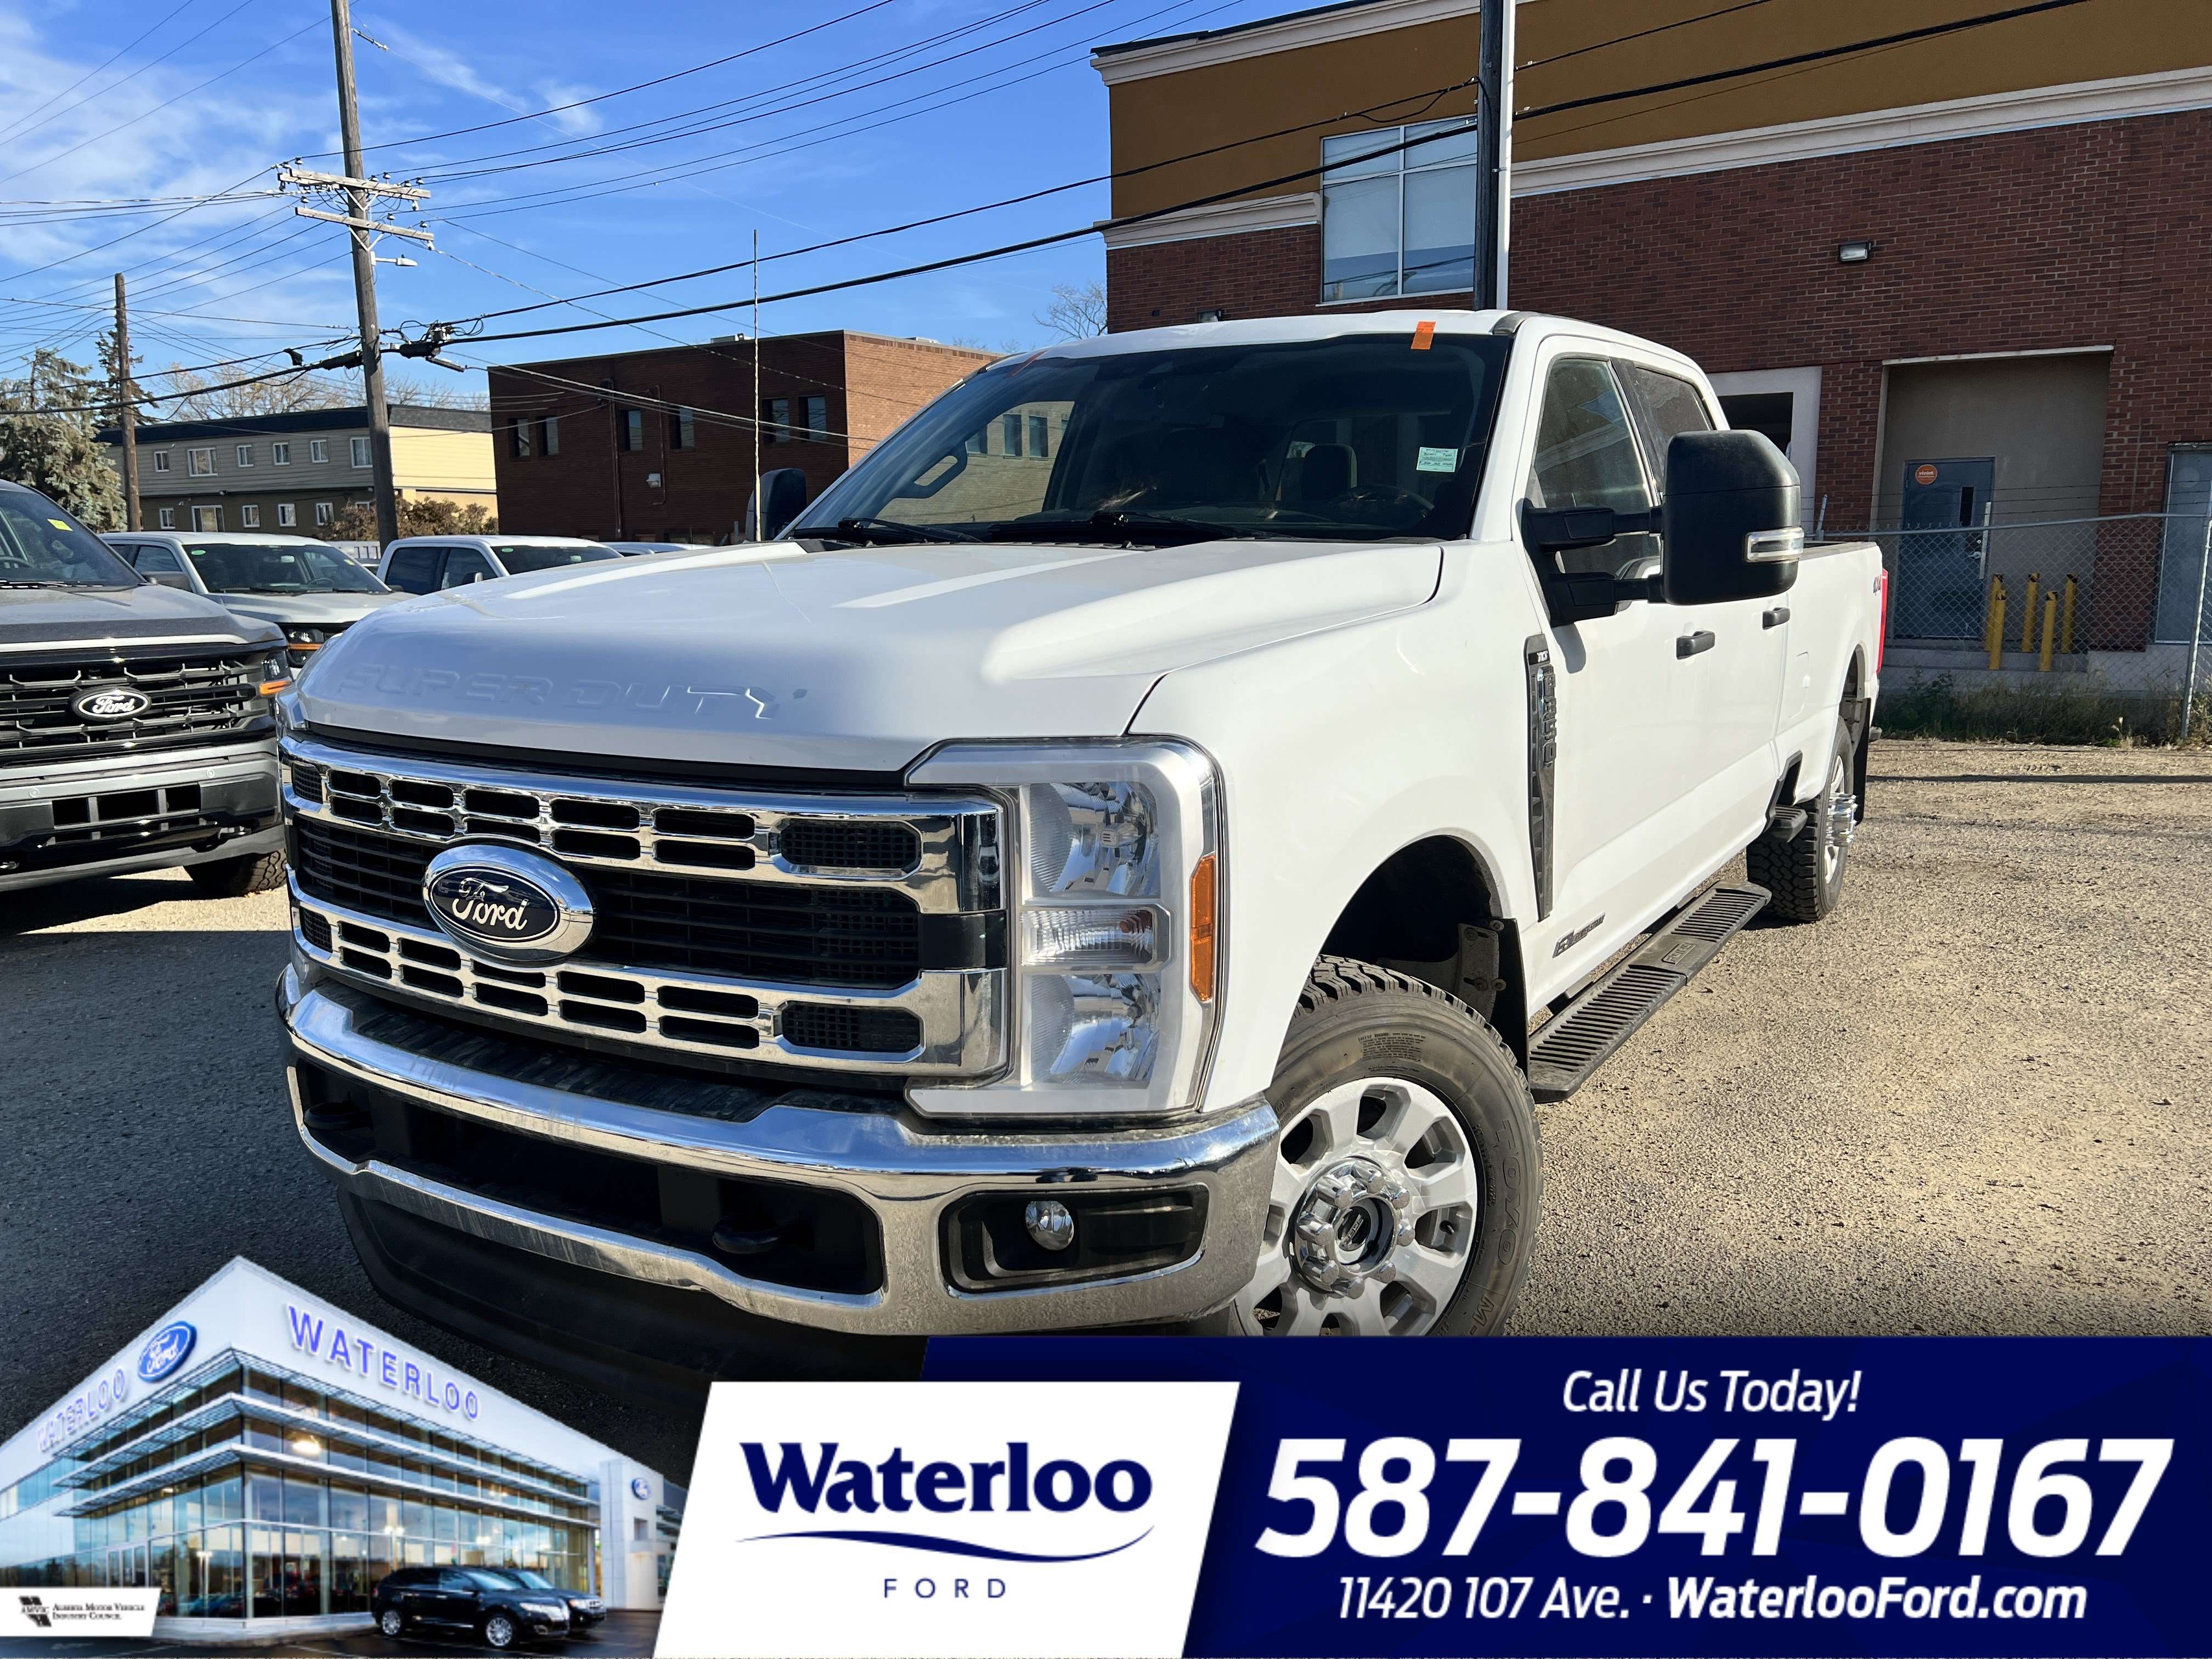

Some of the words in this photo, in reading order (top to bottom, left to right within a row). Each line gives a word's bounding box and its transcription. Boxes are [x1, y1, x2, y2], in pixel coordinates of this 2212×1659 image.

[1537, 650, 1548, 662] XLT
[92, 695, 135, 714] Ford
[338, 662, 553, 706] SUPER
[569, 678, 781, 720] DUTY
[452, 877, 529, 930] Ford
[1496, 1119, 1521, 1265] TOYO
